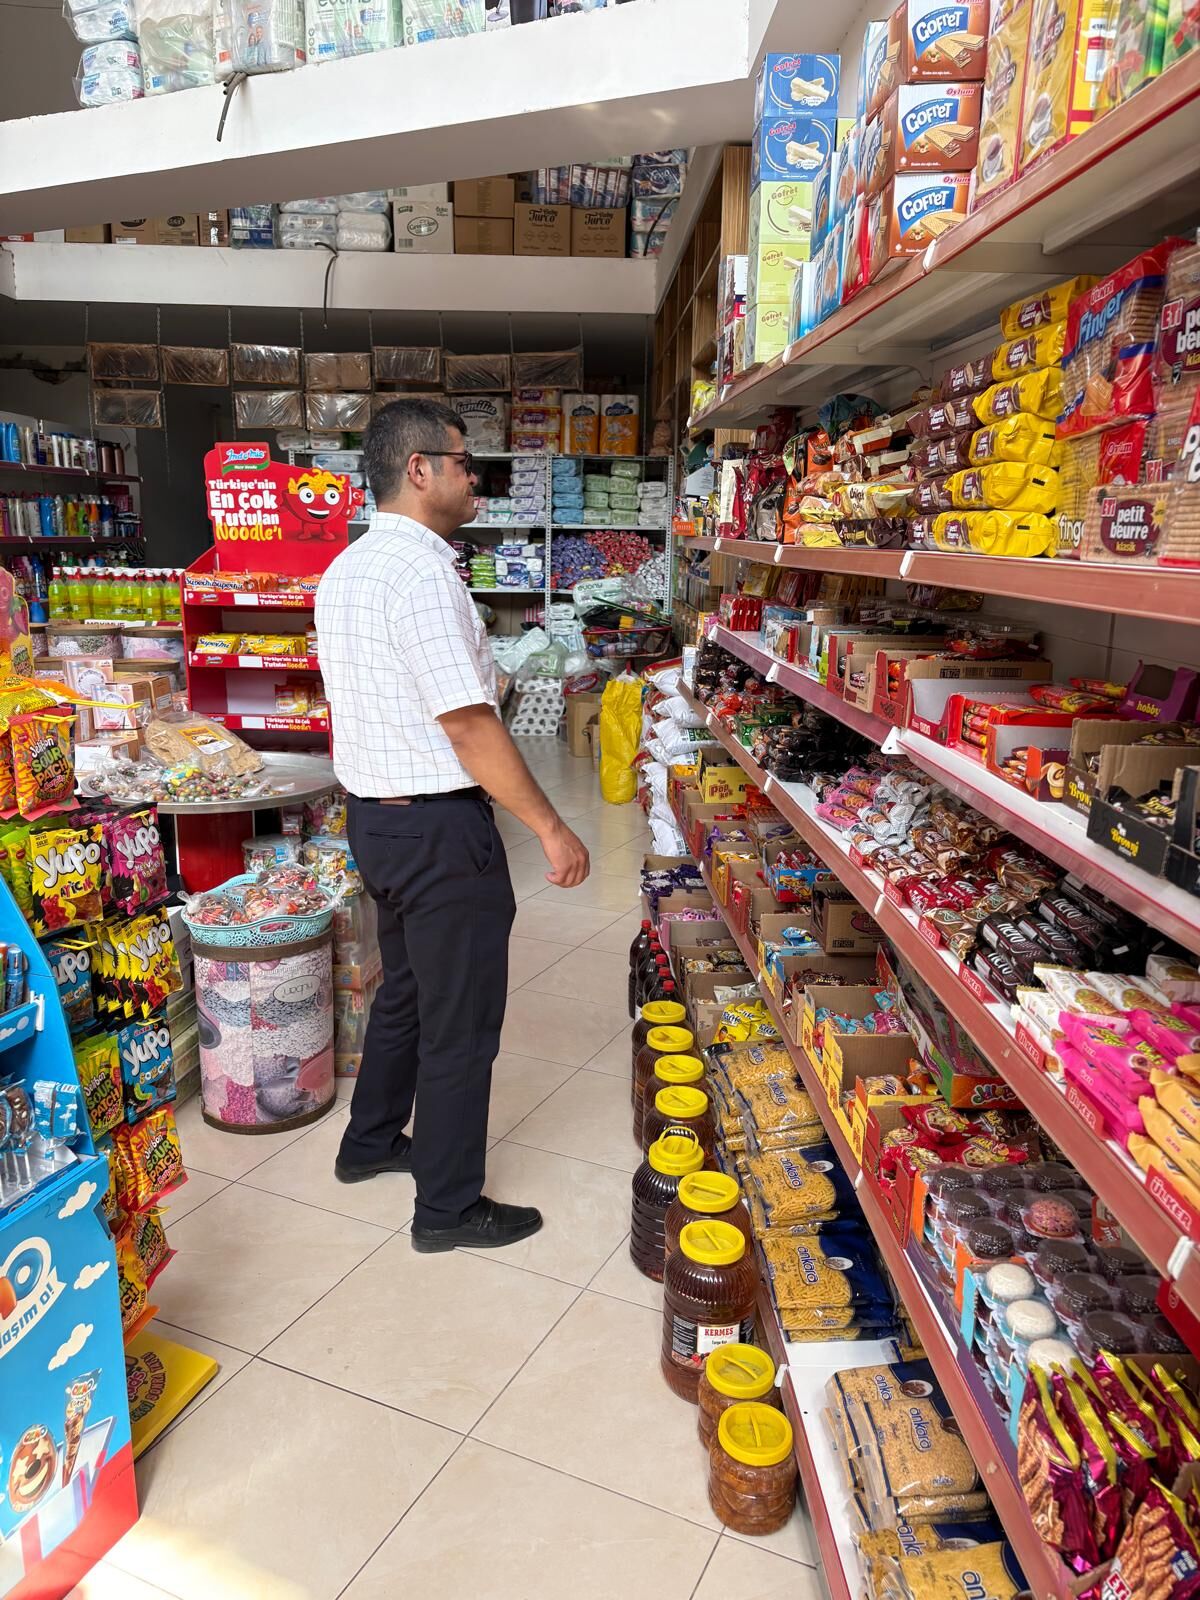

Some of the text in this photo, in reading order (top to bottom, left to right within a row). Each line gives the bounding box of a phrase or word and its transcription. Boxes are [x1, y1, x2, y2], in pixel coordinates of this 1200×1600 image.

[771, 186, 798, 200] Gofret
[762, 251, 783, 262] Gofret
[761, 311, 782, 323] Gofret
[1079, 289, 1125, 350] Finger
[456, 400, 497, 415] familia
[223, 448, 265, 465] Indomie
[208, 479, 277, 491] Türkiye'nin
[210, 490, 278, 510] En Çok
[210, 509, 279, 527] Tutulan
[1117, 506, 1146, 524] petit
[216, 522, 282, 541] Noodle'ı
[1110, 523, 1149, 540] beurre
[1136, 701, 1161, 716] hobby
[31, 747, 62, 773] SOUR
[34, 762, 68, 787] PATCH
[52, 950, 91, 986] upo
[61, 980, 90, 1005] OLUCAN
[86, 1079, 114, 1110] SOUR
[90, 1087, 120, 1124] PATCH
[1068, 1085, 1097, 1131] ÜLKER
[146, 1139, 173, 1172] SOUR
[149, 1145, 180, 1185] PATCH
[779, 1156, 803, 1190] ankara
[1149, 1176, 1193, 1232] ÜLKER
[797, 1246, 818, 1285] ankara
[704, 1327, 734, 1337] KERMES
[909, 1407, 932, 1450] ankara
